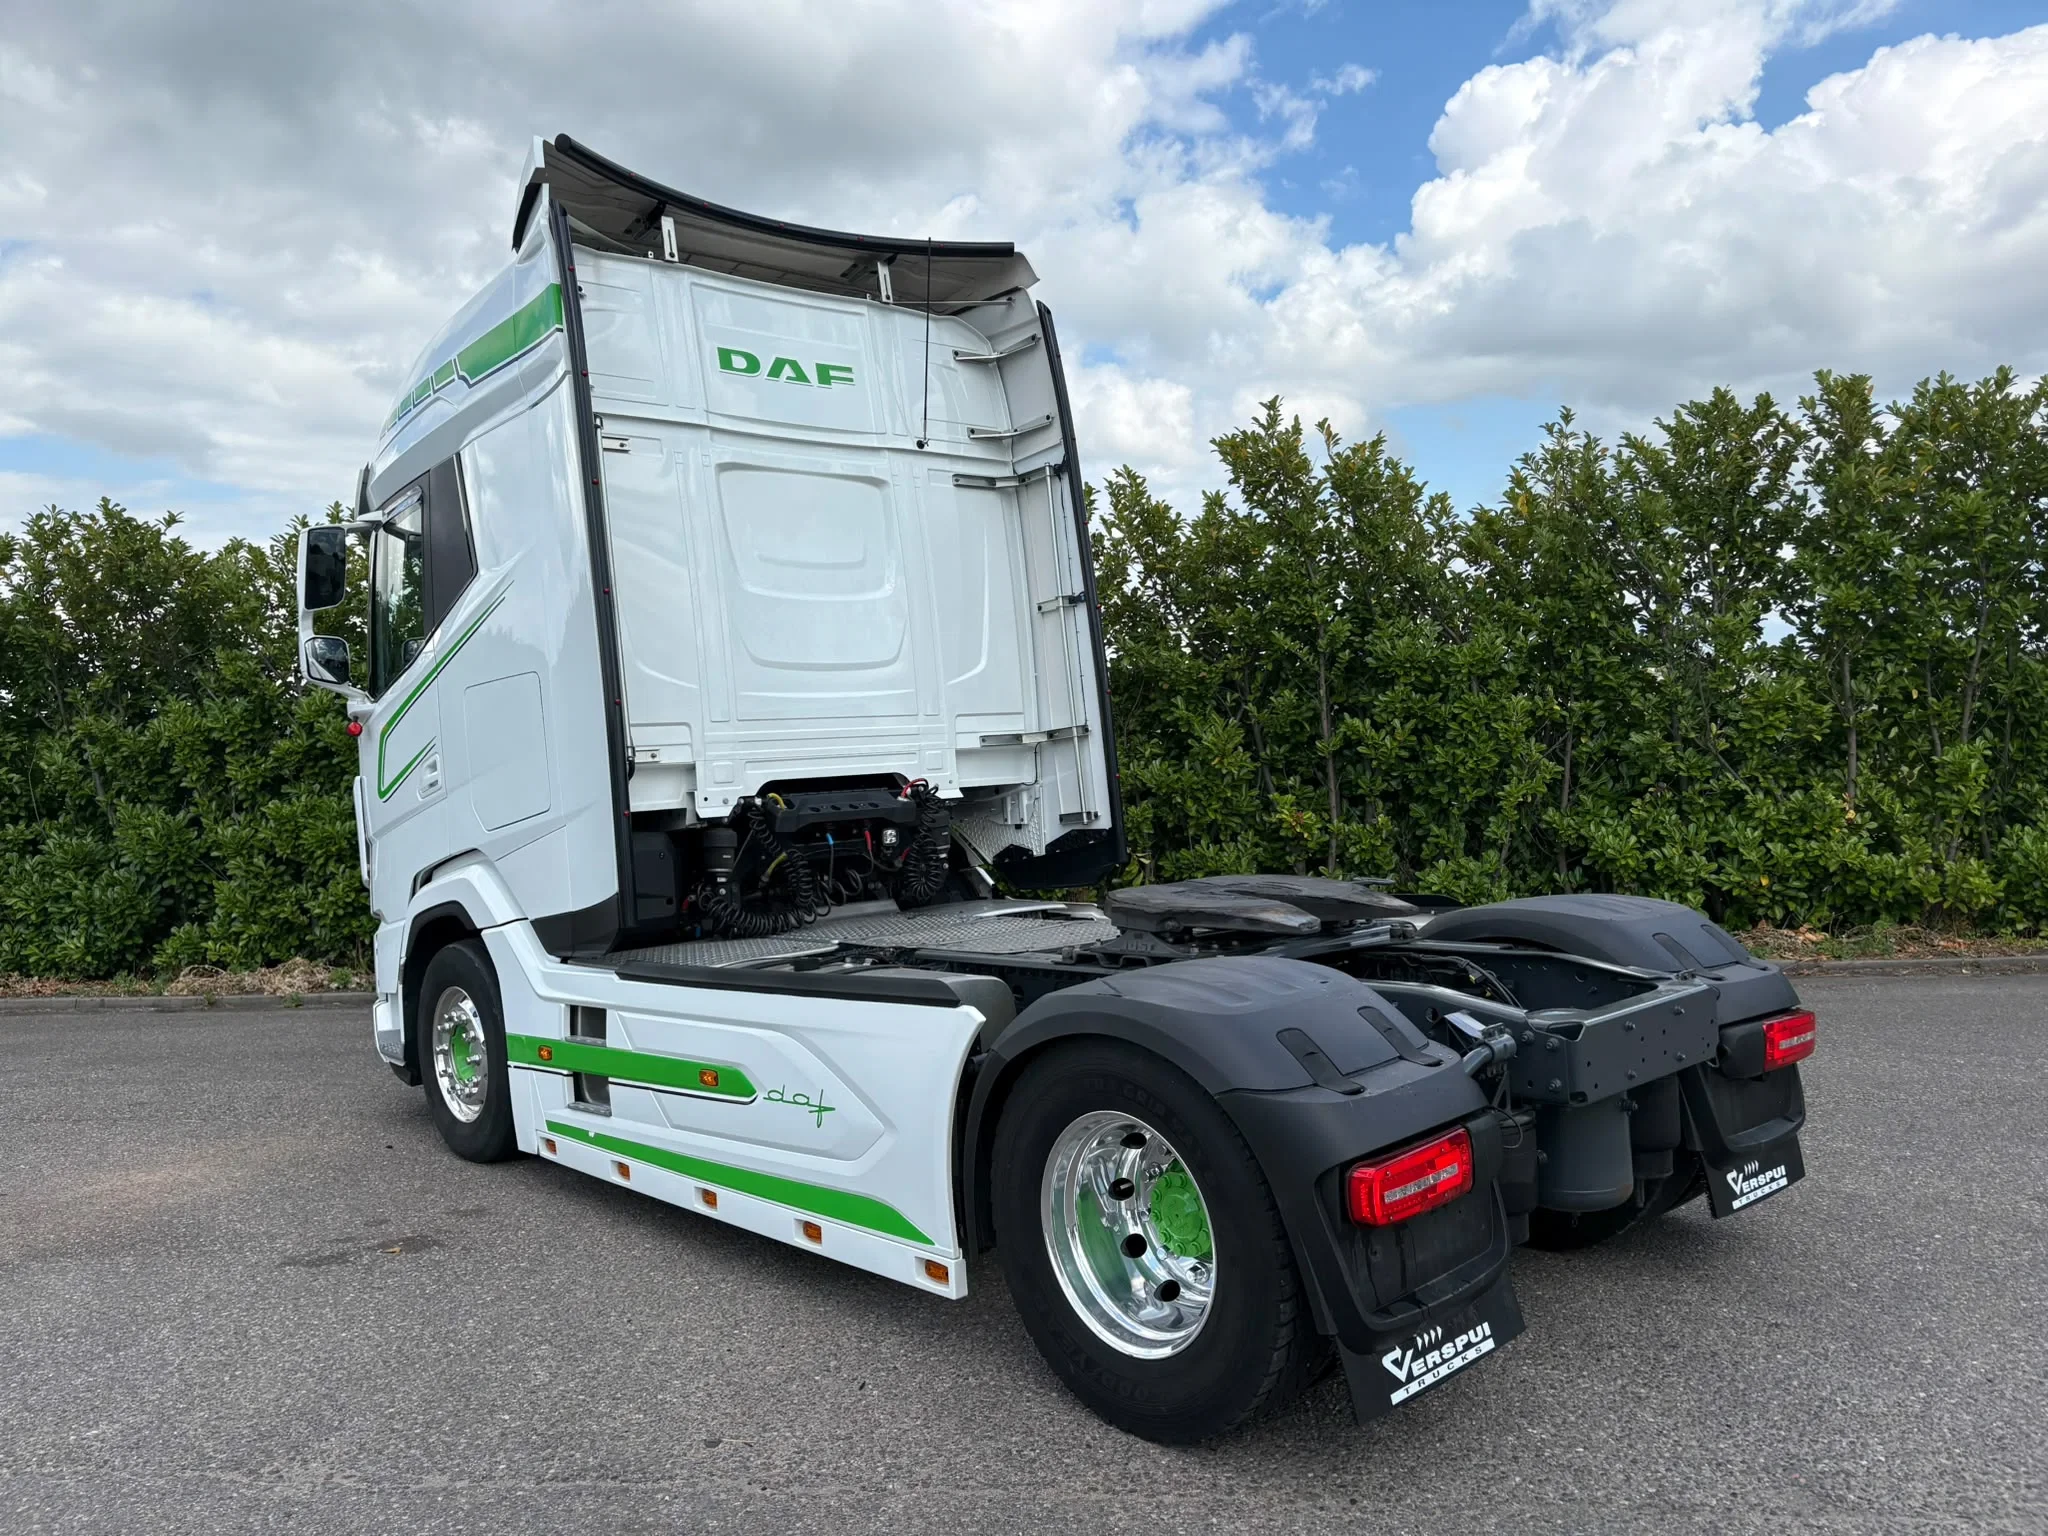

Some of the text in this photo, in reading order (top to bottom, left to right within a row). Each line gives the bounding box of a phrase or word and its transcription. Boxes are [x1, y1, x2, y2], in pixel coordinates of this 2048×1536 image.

[717, 346, 856, 389] DAF
[763, 1084, 836, 1129] daf
[1726, 1165, 1786, 1195] VERSPUI
[1739, 1182, 1781, 1205] TRUCKS
[1381, 1321, 1492, 1383] VERSPUI
[1403, 1346, 1483, 1395] TRUCKS
